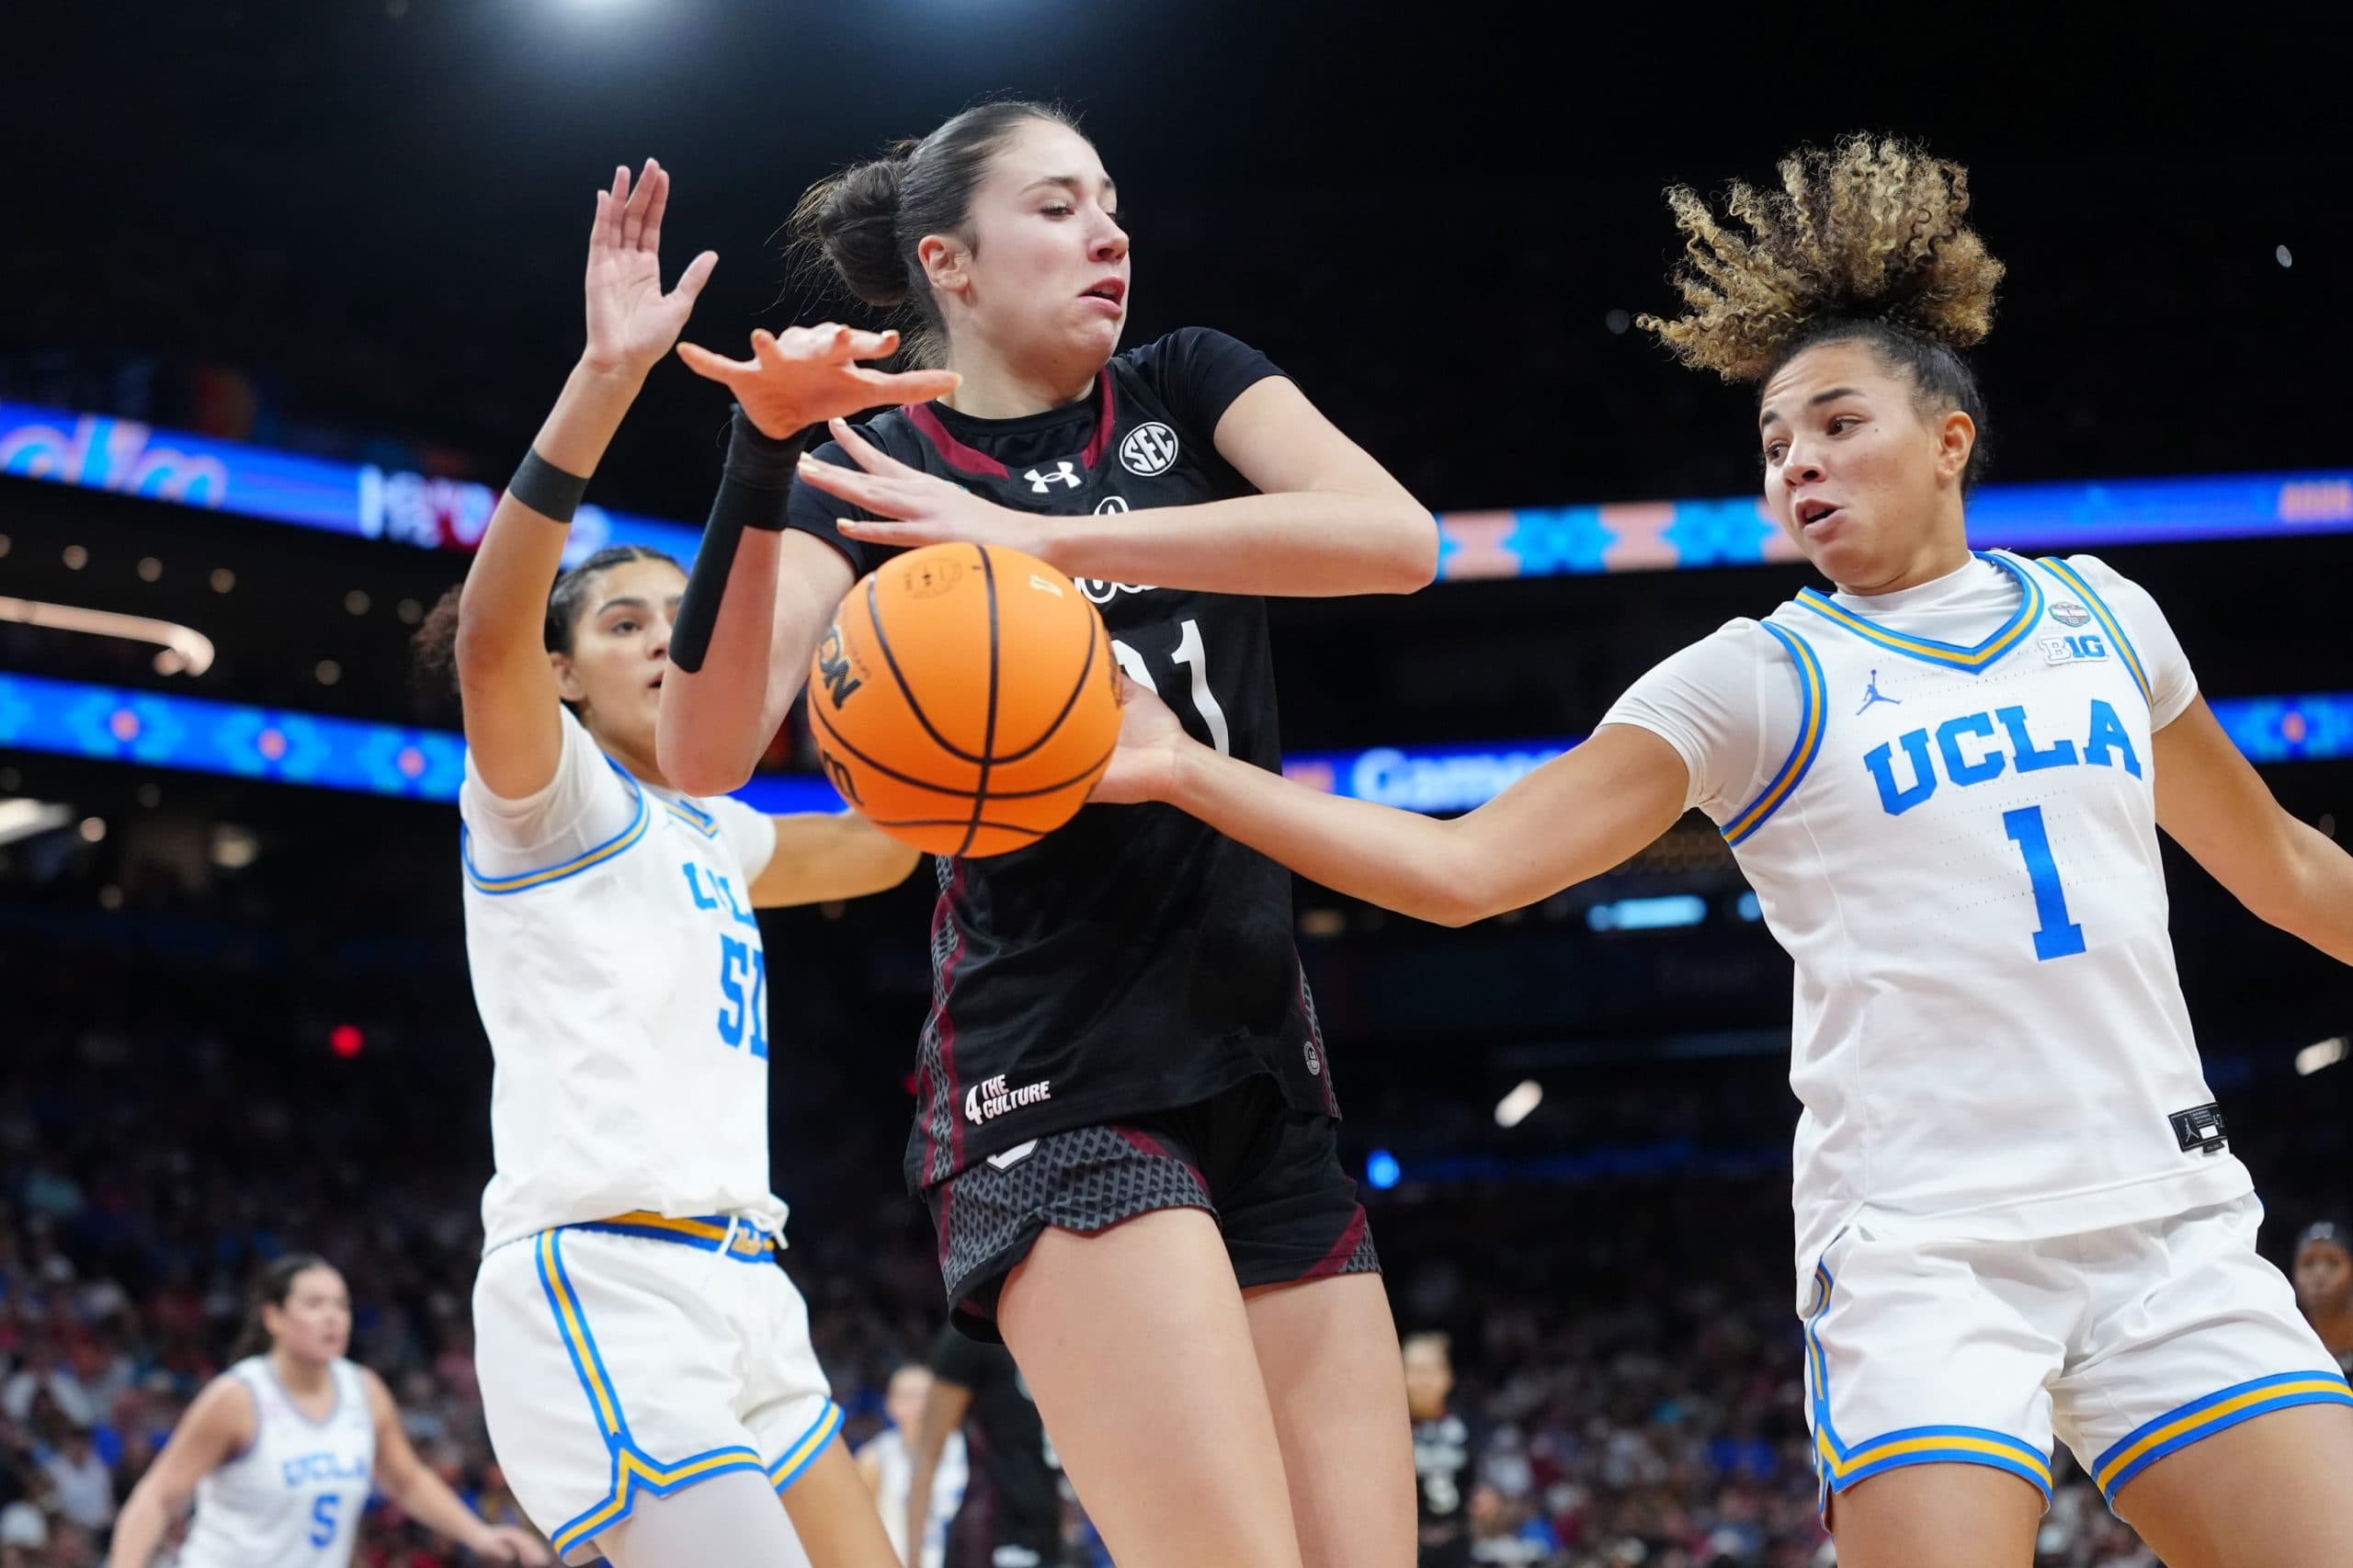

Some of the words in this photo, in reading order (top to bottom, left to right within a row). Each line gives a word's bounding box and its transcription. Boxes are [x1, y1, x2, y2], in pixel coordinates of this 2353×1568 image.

[1124, 426, 1174, 472] SEC
[1863, 699, 2143, 816] UCLA
[2003, 805, 2086, 961] 1
[717, 933, 768, 1062] 51
[965, 1085, 983, 1126] 4
[981, 1074, 1009, 1100] THE
[983, 1081, 1051, 1119] CULTURE
[310, 1493, 340, 1549] 5
